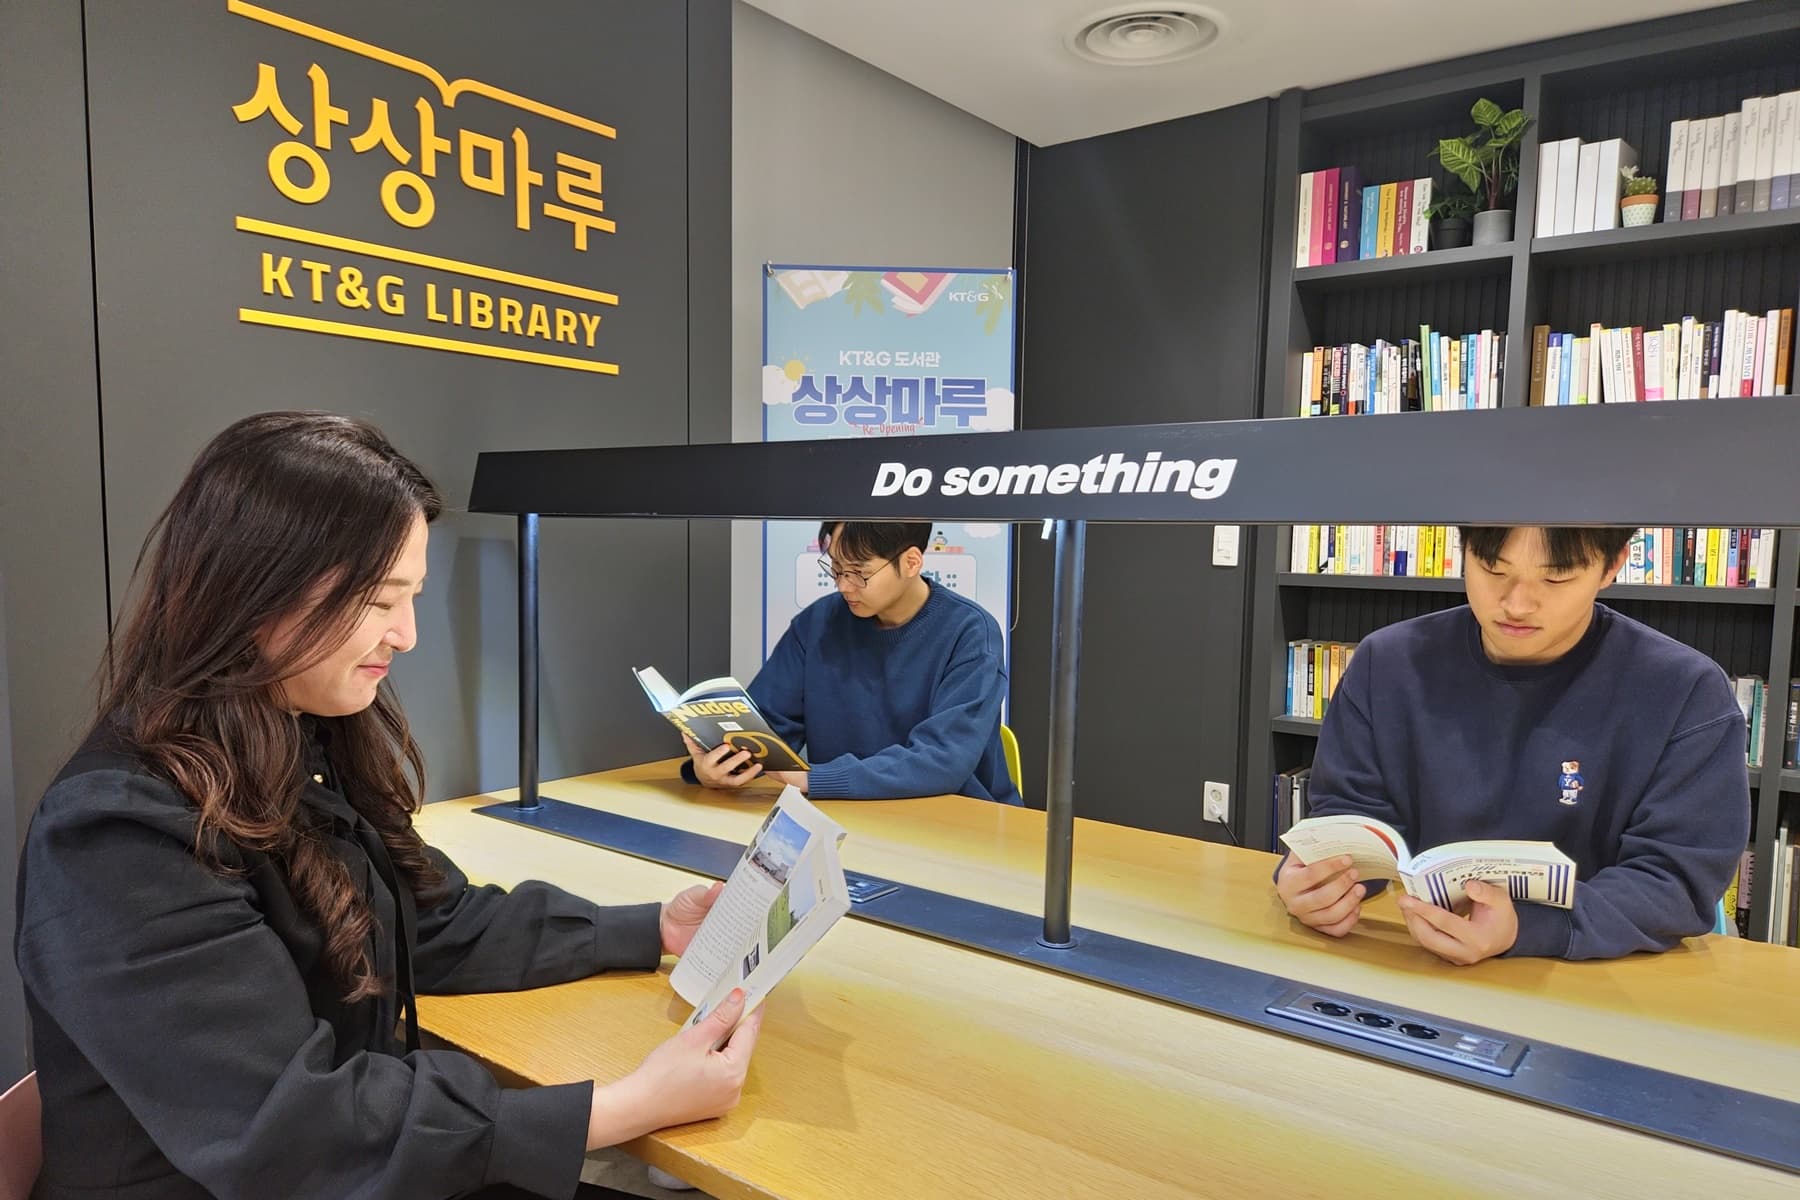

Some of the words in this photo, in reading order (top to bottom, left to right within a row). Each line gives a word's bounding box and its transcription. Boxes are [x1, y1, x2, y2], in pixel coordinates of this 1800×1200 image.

[231, 62, 617, 252] 상상마루
[261, 252, 406, 316] KT&G
[427, 283, 602, 348] LIBRARY
[948, 290, 990, 304] KT&G
[839, 350, 892, 367] KT&G
[895, 351, 942, 368] 도서관
[790, 374, 988, 427] 상상마루
[871, 462, 932, 497] Do
[940, 452, 1238, 500] something
[671, 701, 752, 722] Nudge
